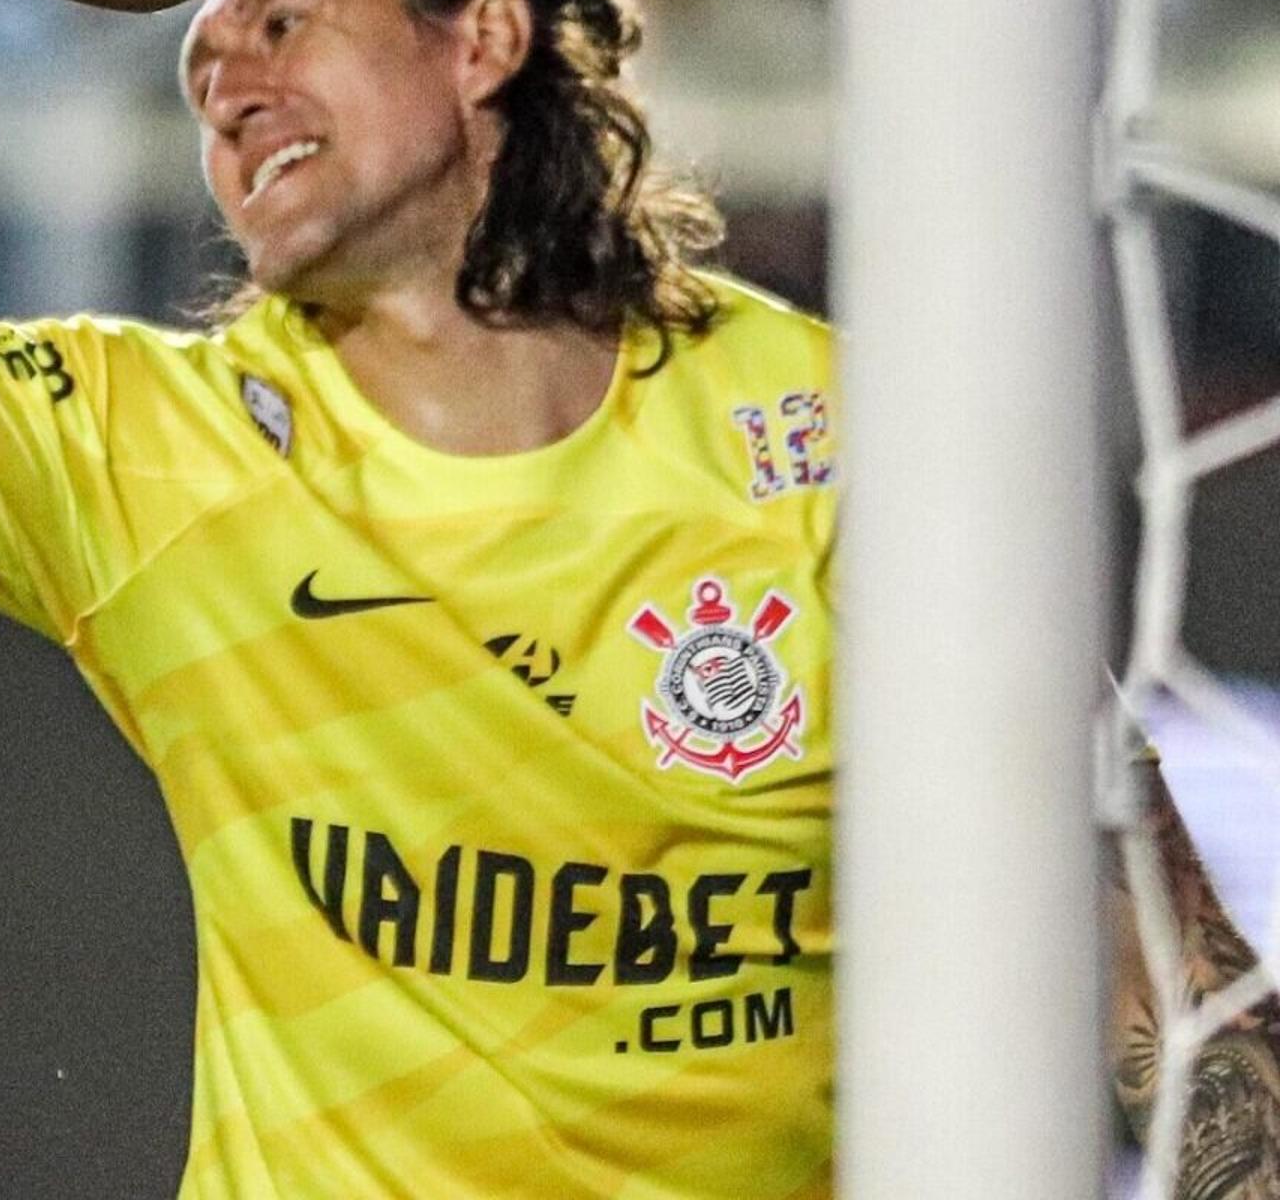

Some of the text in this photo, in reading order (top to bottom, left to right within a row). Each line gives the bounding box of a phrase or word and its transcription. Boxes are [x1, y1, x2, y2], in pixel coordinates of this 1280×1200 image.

[732, 391, 833, 500] 12
[290, 816, 813, 987] VAIDEBET
[614, 987, 795, 1055] .COM
